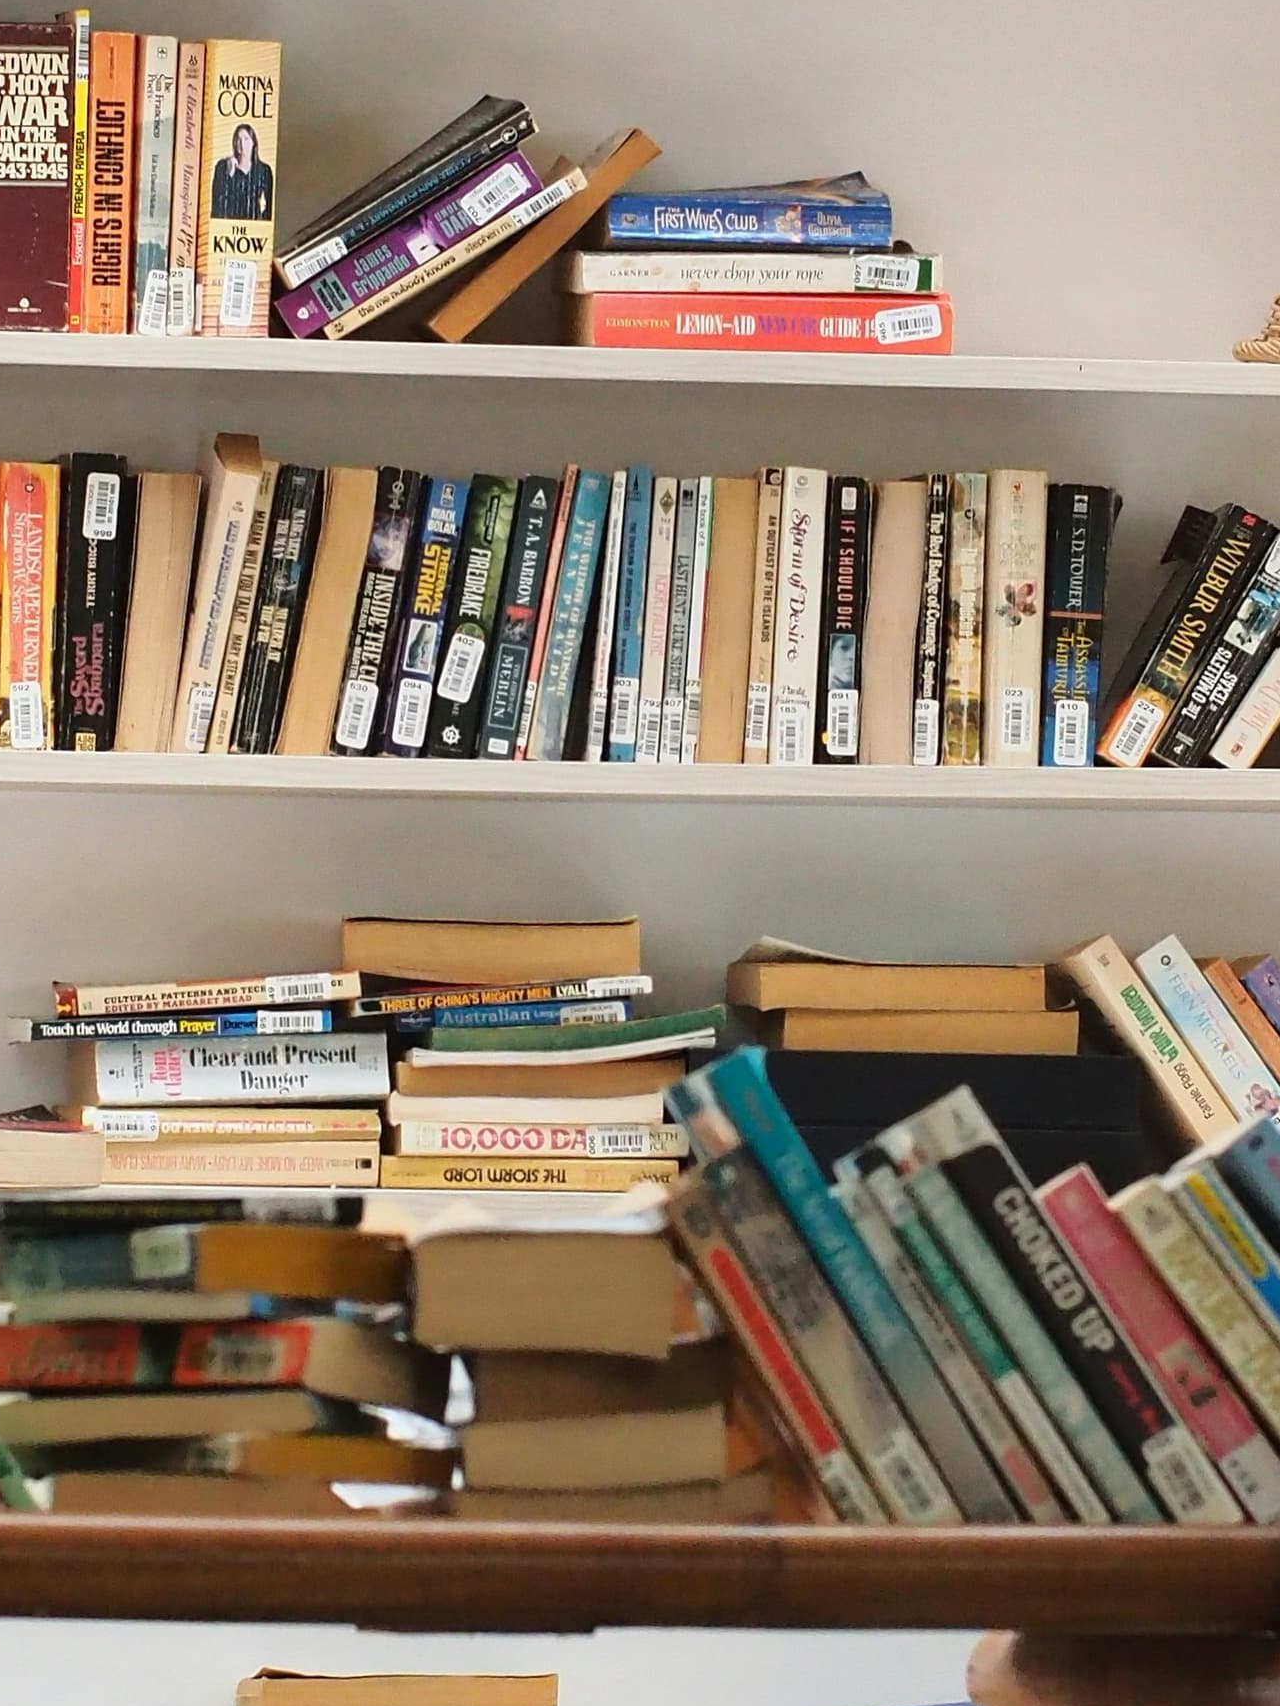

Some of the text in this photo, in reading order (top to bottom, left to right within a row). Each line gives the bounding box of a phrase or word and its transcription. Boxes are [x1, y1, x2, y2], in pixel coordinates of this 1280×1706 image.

[8, 75, 68, 95] HOYT
[219, 75, 274, 92] MARTINA
[217, 92, 274, 120] COLE
[0, 127, 57, 143] IN THE
[73, 130, 86, 216] FRENCH RIVIERA
[92, 98, 125, 287] RIGHTS IN CONFLICT
[232, 226, 247, 236] THE
[654, 207, 758, 234] FIRST WIVES CLUB
[73, 222, 84, 266] Essential
[213, 237, 268, 254] KNOW
[229, 262, 247, 270] 230
[352, 244, 393, 273] James
[609, 261, 824, 283] GARNER never chop your rope
[351, 255, 411, 298] Grippando
[430, 509, 456, 522] MACK
[288, 508, 306, 561] MARGARET
[86, 573, 98, 609] TERRY
[414, 545, 441, 617] STRIKE
[433, 547, 451, 615] THERMAL
[459, 547, 491, 620] FIREDRAKE
[22, 513, 44, 684] LANDSCAPE TURNED
[1156, 538, 1251, 680] WILBUR SMITH
[370, 573, 395, 663] INSIDE THE
[493, 655, 515, 719] MERLIN
[1181, 646, 1233, 720] THE O'MALLEYS
[1211, 671, 1238, 707] TEXAS
[1137, 700, 1156, 715] 224
[103, 987, 238, 1005] CULTURAL PATTERNS AND
[40, 1018, 216, 1037] Touch the World through Prayer
[442, 1008, 531, 1027] Australian
[150, 1049, 166, 1084] Tom
[188, 1042, 358, 1068] Clear and Present
[240, 1070, 309, 1093] Danger
[440, 1126, 546, 1153] 10,000
[443, 1167, 567, 1184] THE STORM LORD
[993, 1187, 1116, 1351] CHOKED UP
